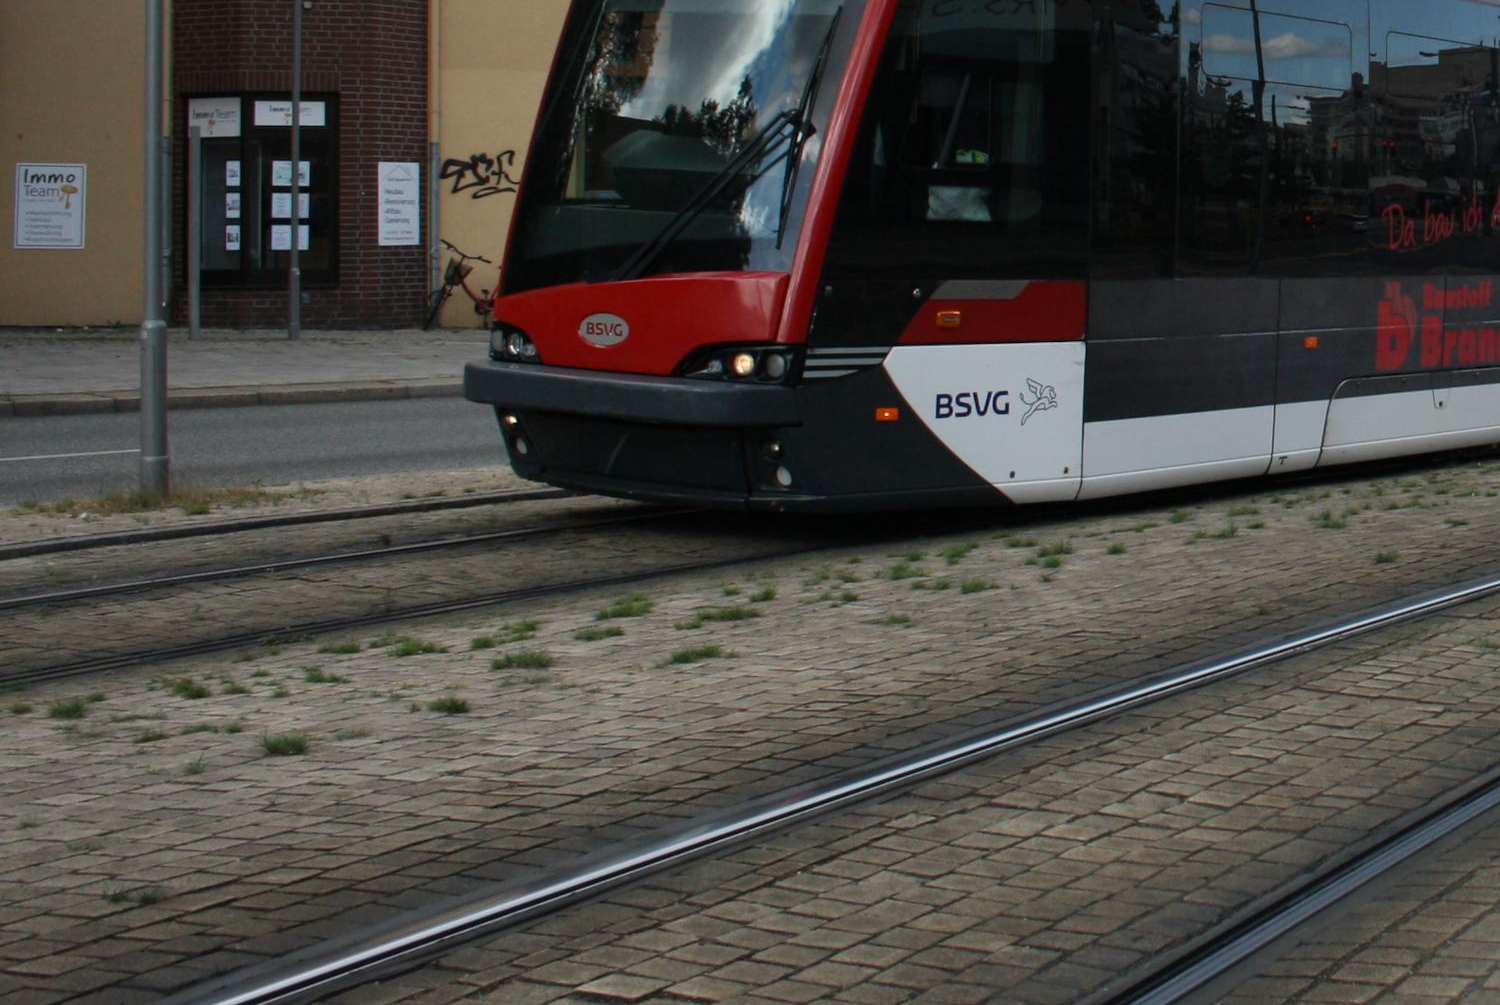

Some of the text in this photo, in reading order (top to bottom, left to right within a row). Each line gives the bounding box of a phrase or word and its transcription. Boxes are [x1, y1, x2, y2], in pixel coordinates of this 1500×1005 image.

[23, 168, 76, 184] Immo
[23, 184, 60, 197] Team
[1382, 202, 1417, 250] Da
[585, 321, 624, 338] BSVG
[935, 390, 1011, 419] BSVG
